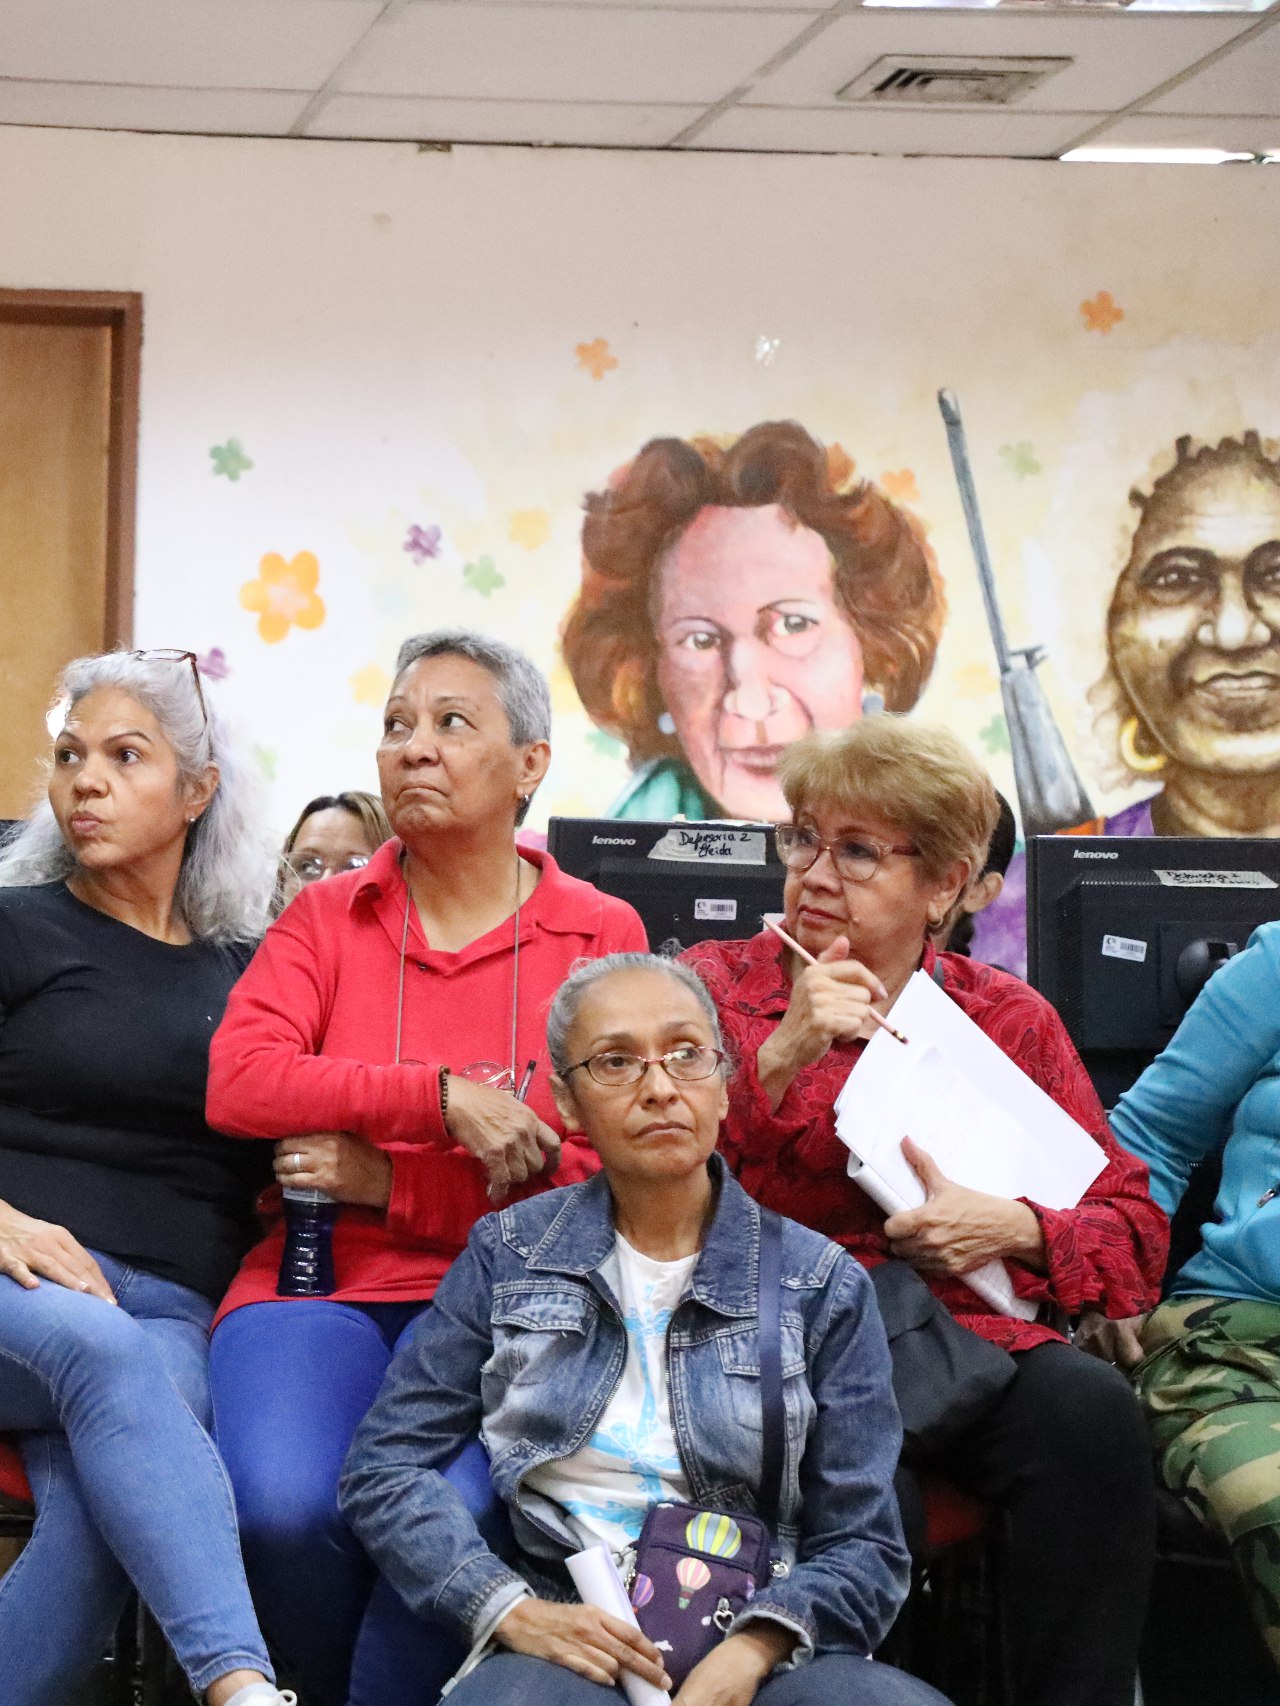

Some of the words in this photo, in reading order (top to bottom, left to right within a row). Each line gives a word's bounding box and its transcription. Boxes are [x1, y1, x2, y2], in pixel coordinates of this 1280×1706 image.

[592, 835, 636, 846] lenovo
[740, 833, 751, 842] 2
[1073, 849, 1119, 860] lenovo
